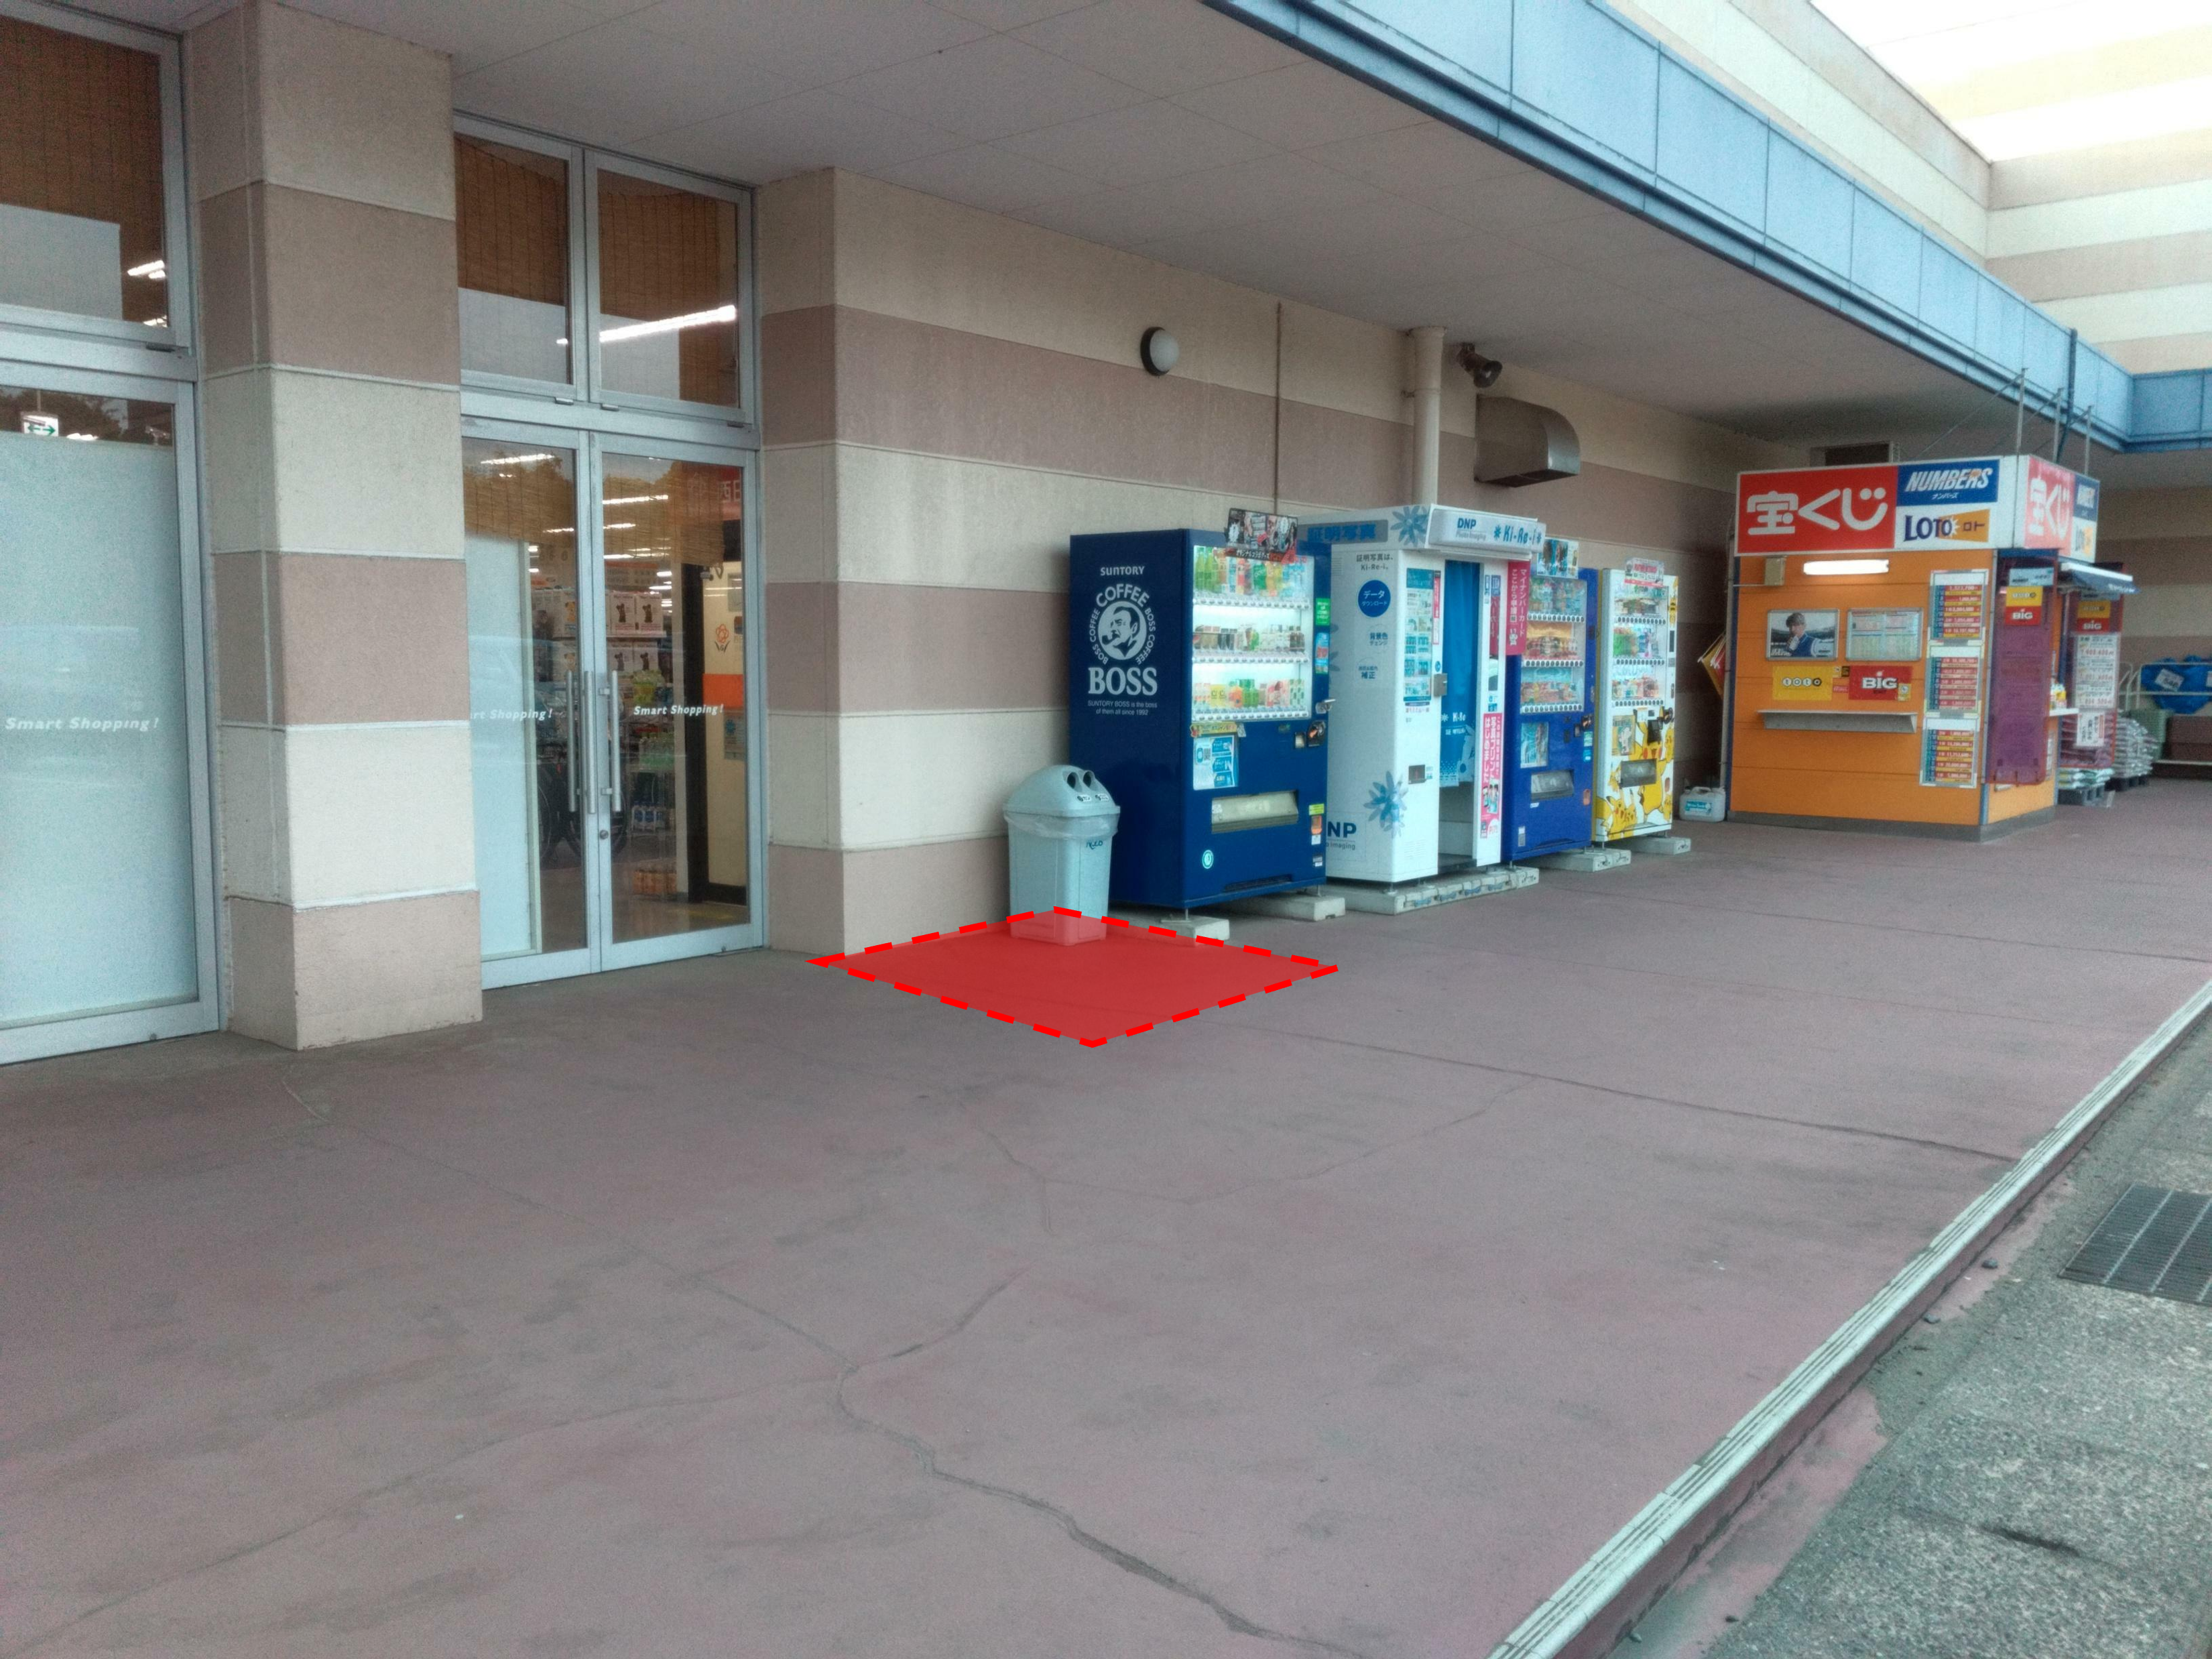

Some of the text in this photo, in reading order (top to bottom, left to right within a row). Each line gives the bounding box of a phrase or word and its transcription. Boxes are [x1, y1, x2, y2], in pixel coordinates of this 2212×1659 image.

[1904, 467, 1993, 492] NUMBERS
[1746, 487, 1888, 536] 宝くじ
[2029, 477, 2070, 540] 宝くじ
[1457, 517, 1477, 530] DNP
[1903, 514, 1953, 542] LOTO
[1096, 583, 1150, 607] COFFEE
[1363, 590, 1385, 599] データ
[1518, 569, 1528, 637] マイナンバーカード
[1089, 608, 1109, 665] BOSS COFFEE
[1135, 607, 1156, 665] BOSS COFFEE
[1088, 667, 1158, 696] BOSS
[1782, 677, 1823, 687] toto
[489, 709, 553, 721] Shopping!
[633, 704, 723, 717] Smart Shopping!
[5, 717, 159, 732] Smart Shopping!
[1327, 821, 1357, 838] NP
[1330, 842, 1356, 851] Imaging
